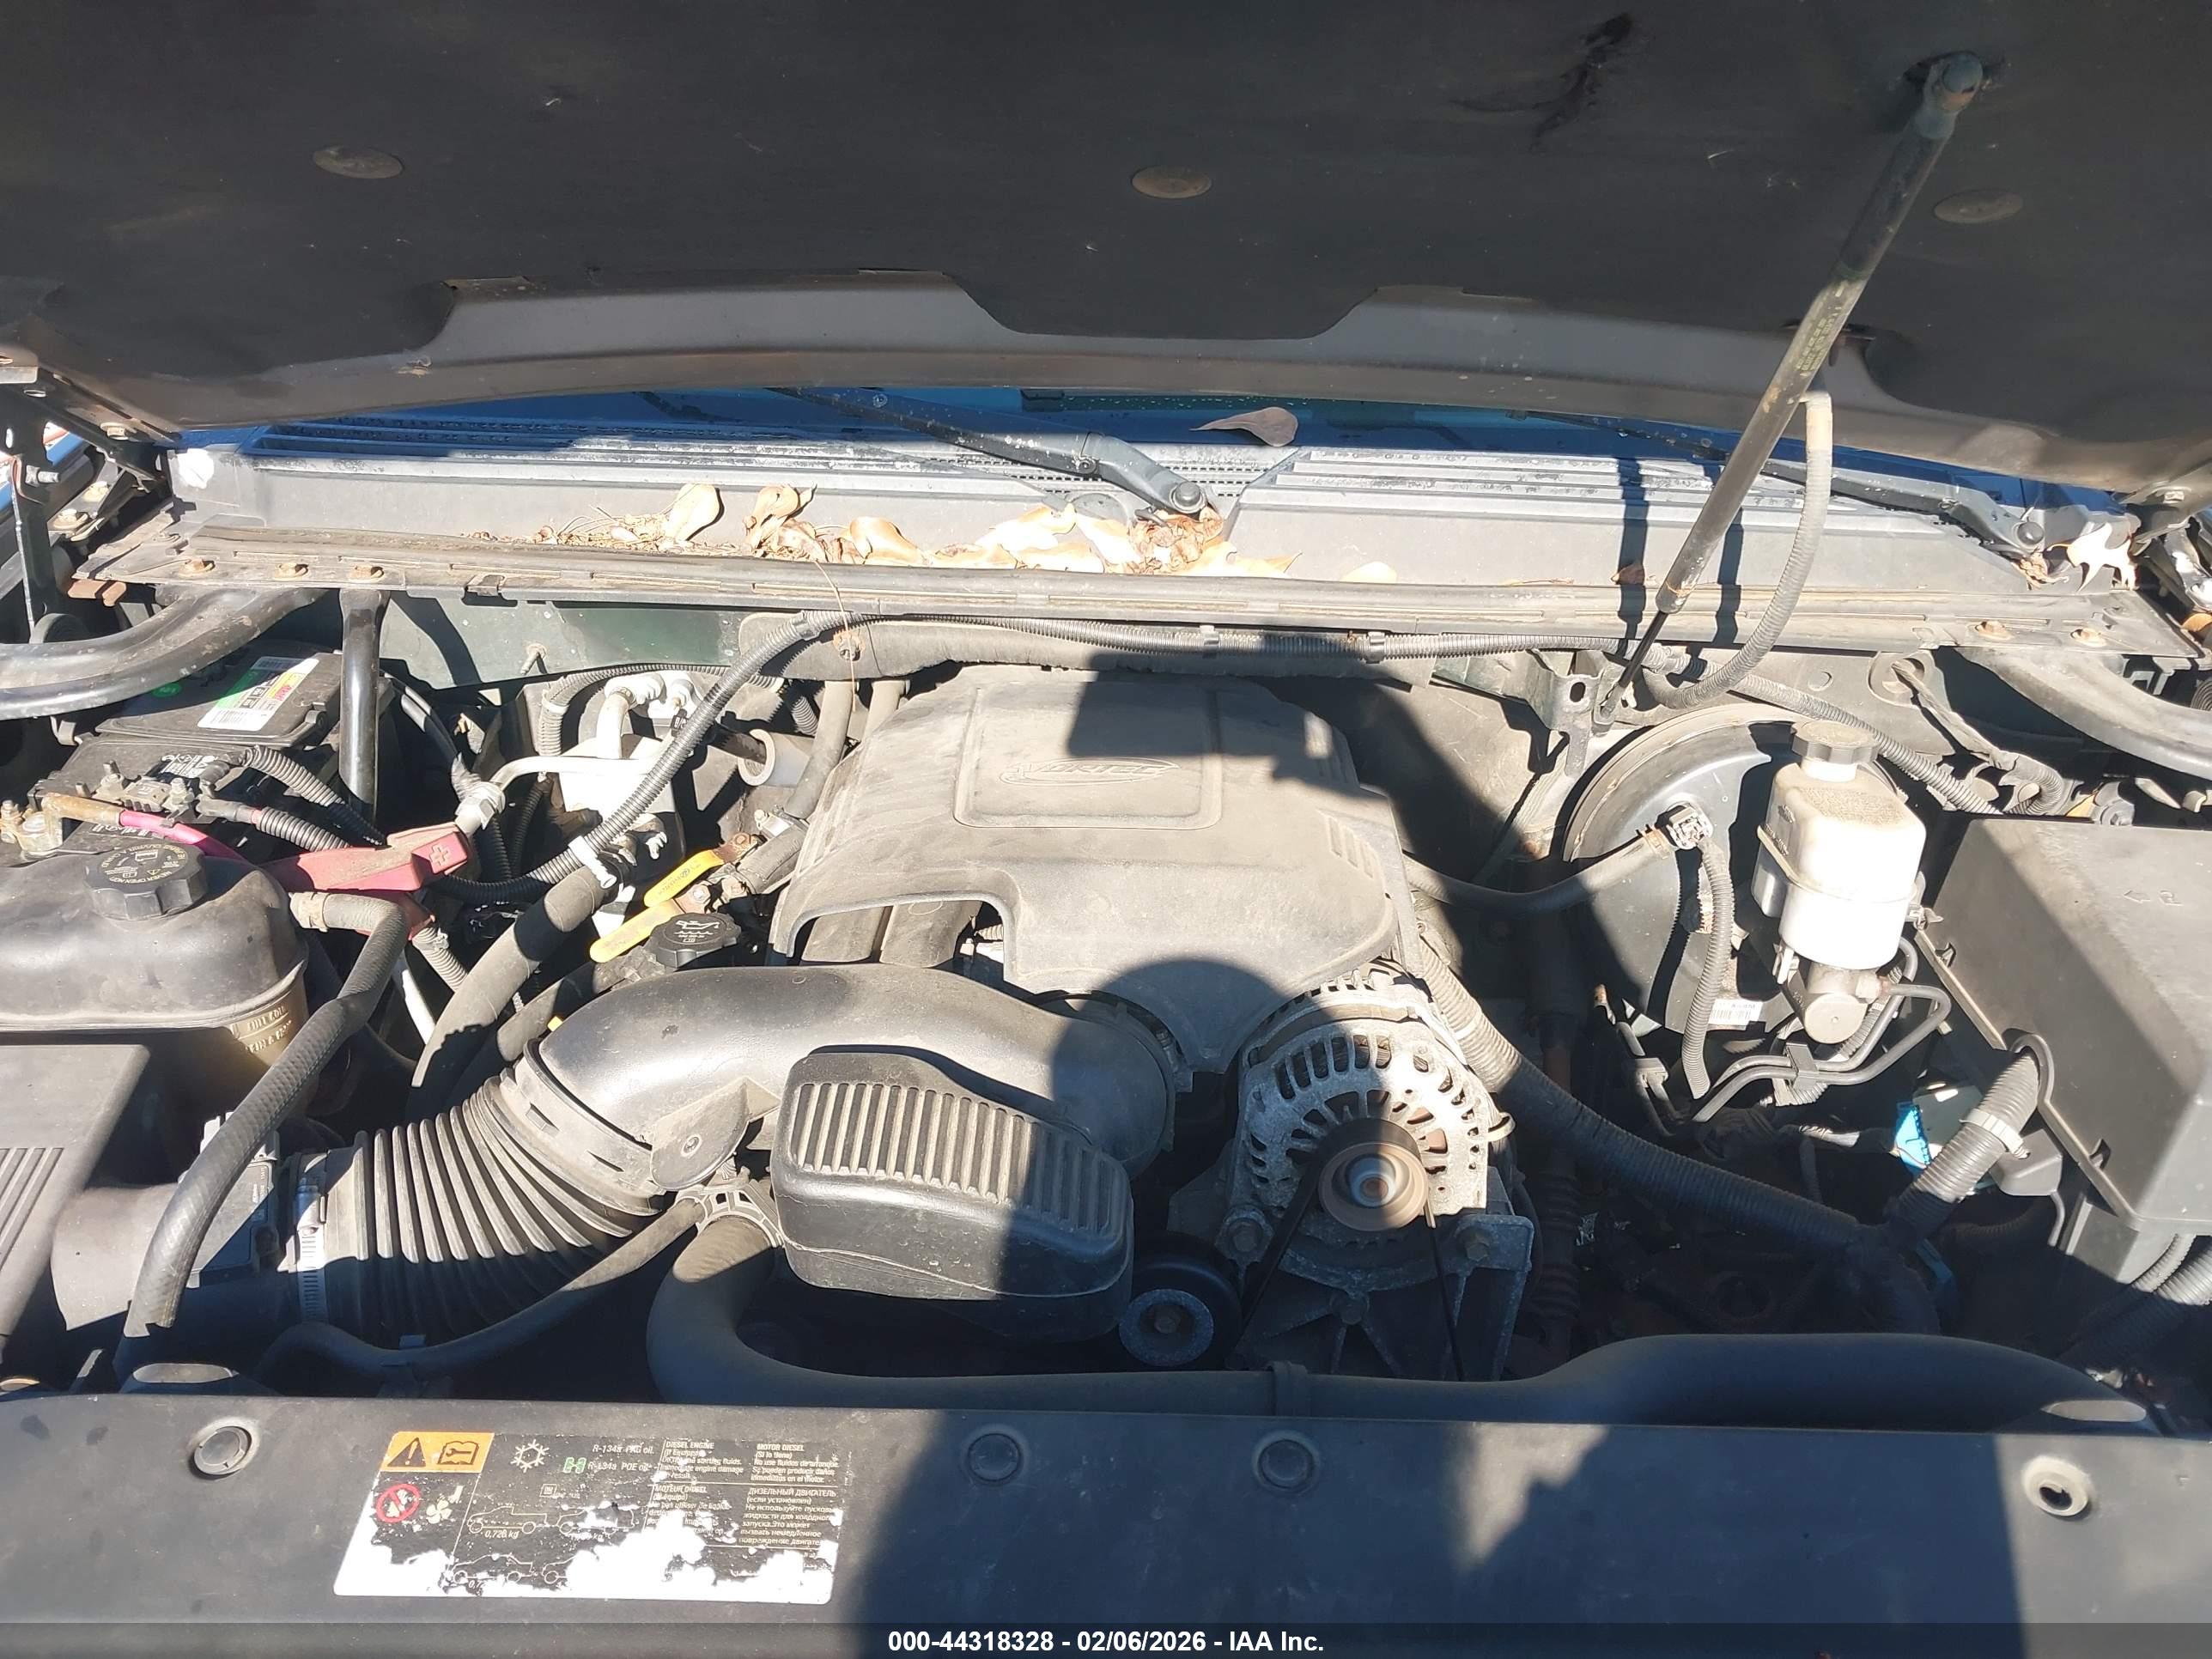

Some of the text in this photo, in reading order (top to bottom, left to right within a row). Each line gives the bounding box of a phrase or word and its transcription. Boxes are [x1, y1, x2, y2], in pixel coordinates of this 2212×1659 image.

[621, 1462, 638, 1471] POE
[748, 1487, 794, 1496] ДИЗЕЛЬНЫЙ
[508, 1530, 520, 1540] kg
